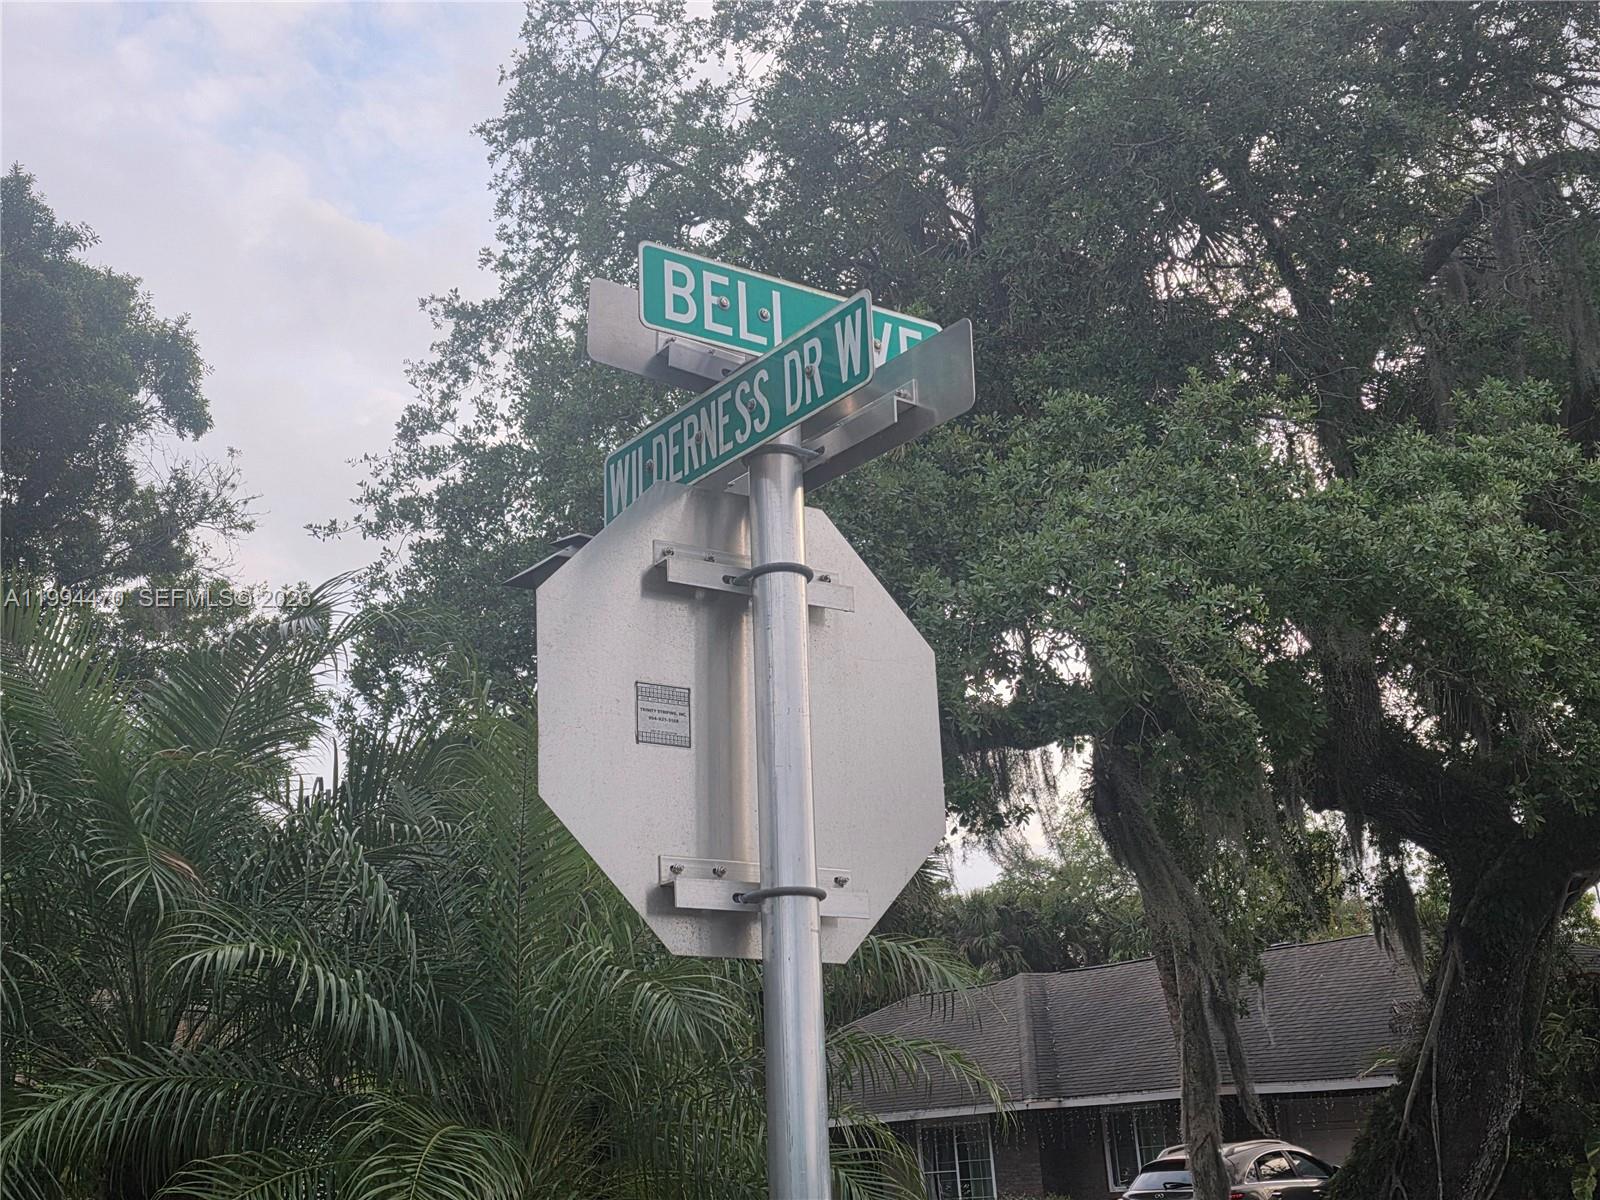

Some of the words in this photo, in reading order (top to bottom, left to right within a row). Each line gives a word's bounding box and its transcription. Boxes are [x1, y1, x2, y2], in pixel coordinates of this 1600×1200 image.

[609, 370, 770, 517] WILDERNESS
[784, 337, 825, 416] DR
[834, 307, 863, 384] W
